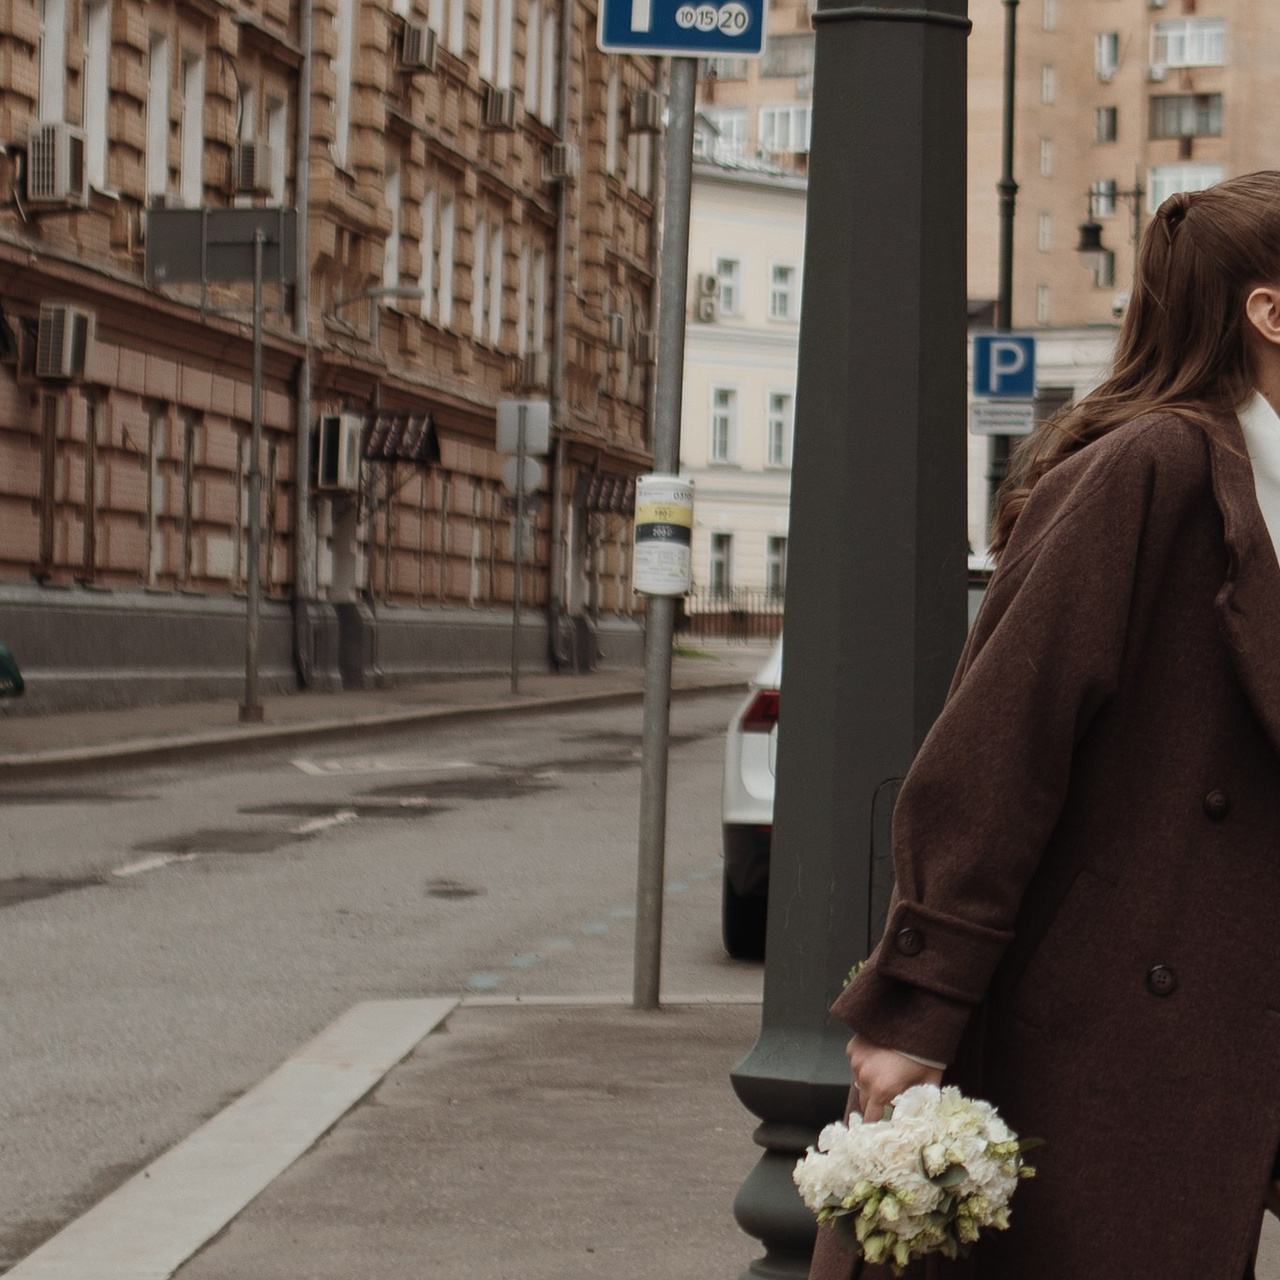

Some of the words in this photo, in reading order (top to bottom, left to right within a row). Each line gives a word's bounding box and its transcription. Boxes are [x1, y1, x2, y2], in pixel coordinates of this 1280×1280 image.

[680, 10, 694, 24] 10
[698, 10, 714, 26] 15
[720, 10, 747, 30] 20
[989, 341, 1025, 393] P
